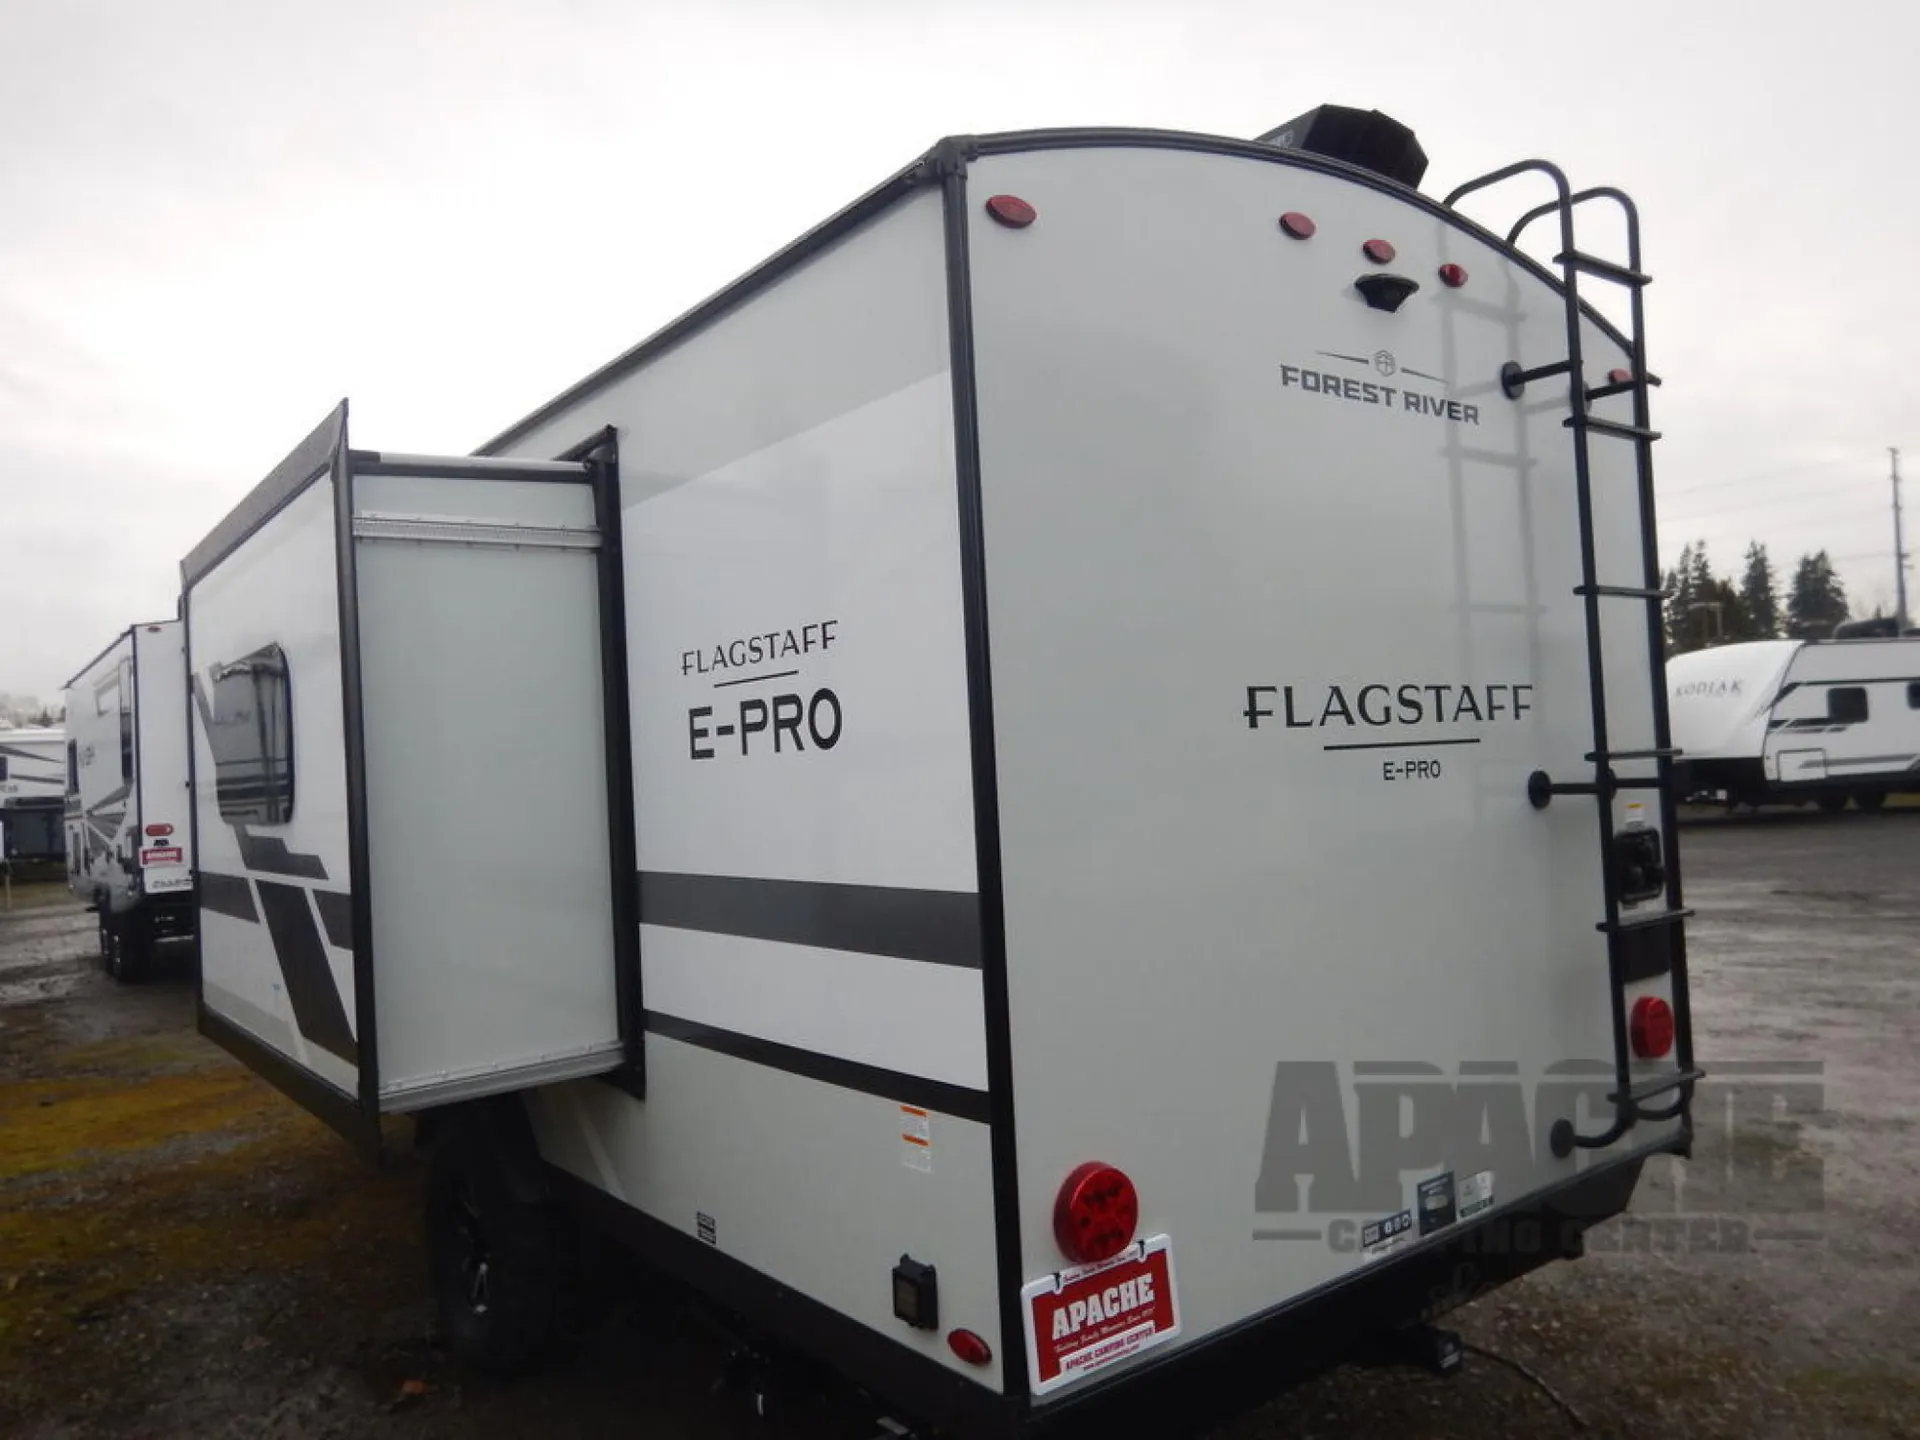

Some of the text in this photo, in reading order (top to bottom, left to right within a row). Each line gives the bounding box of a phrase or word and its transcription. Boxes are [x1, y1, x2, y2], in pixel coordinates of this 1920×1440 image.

[1280, 363, 1480, 425] FOREST RIVER
[681, 619, 839, 676] FLAGSTAFF
[1243, 683, 1533, 729] FLAGSTAFF
[1675, 679, 1743, 698] KODIAK
[688, 687, 843, 760] E-PRO
[1383, 759, 1442, 781] E-PRO
[1052, 1272, 1155, 1341] APACHE
